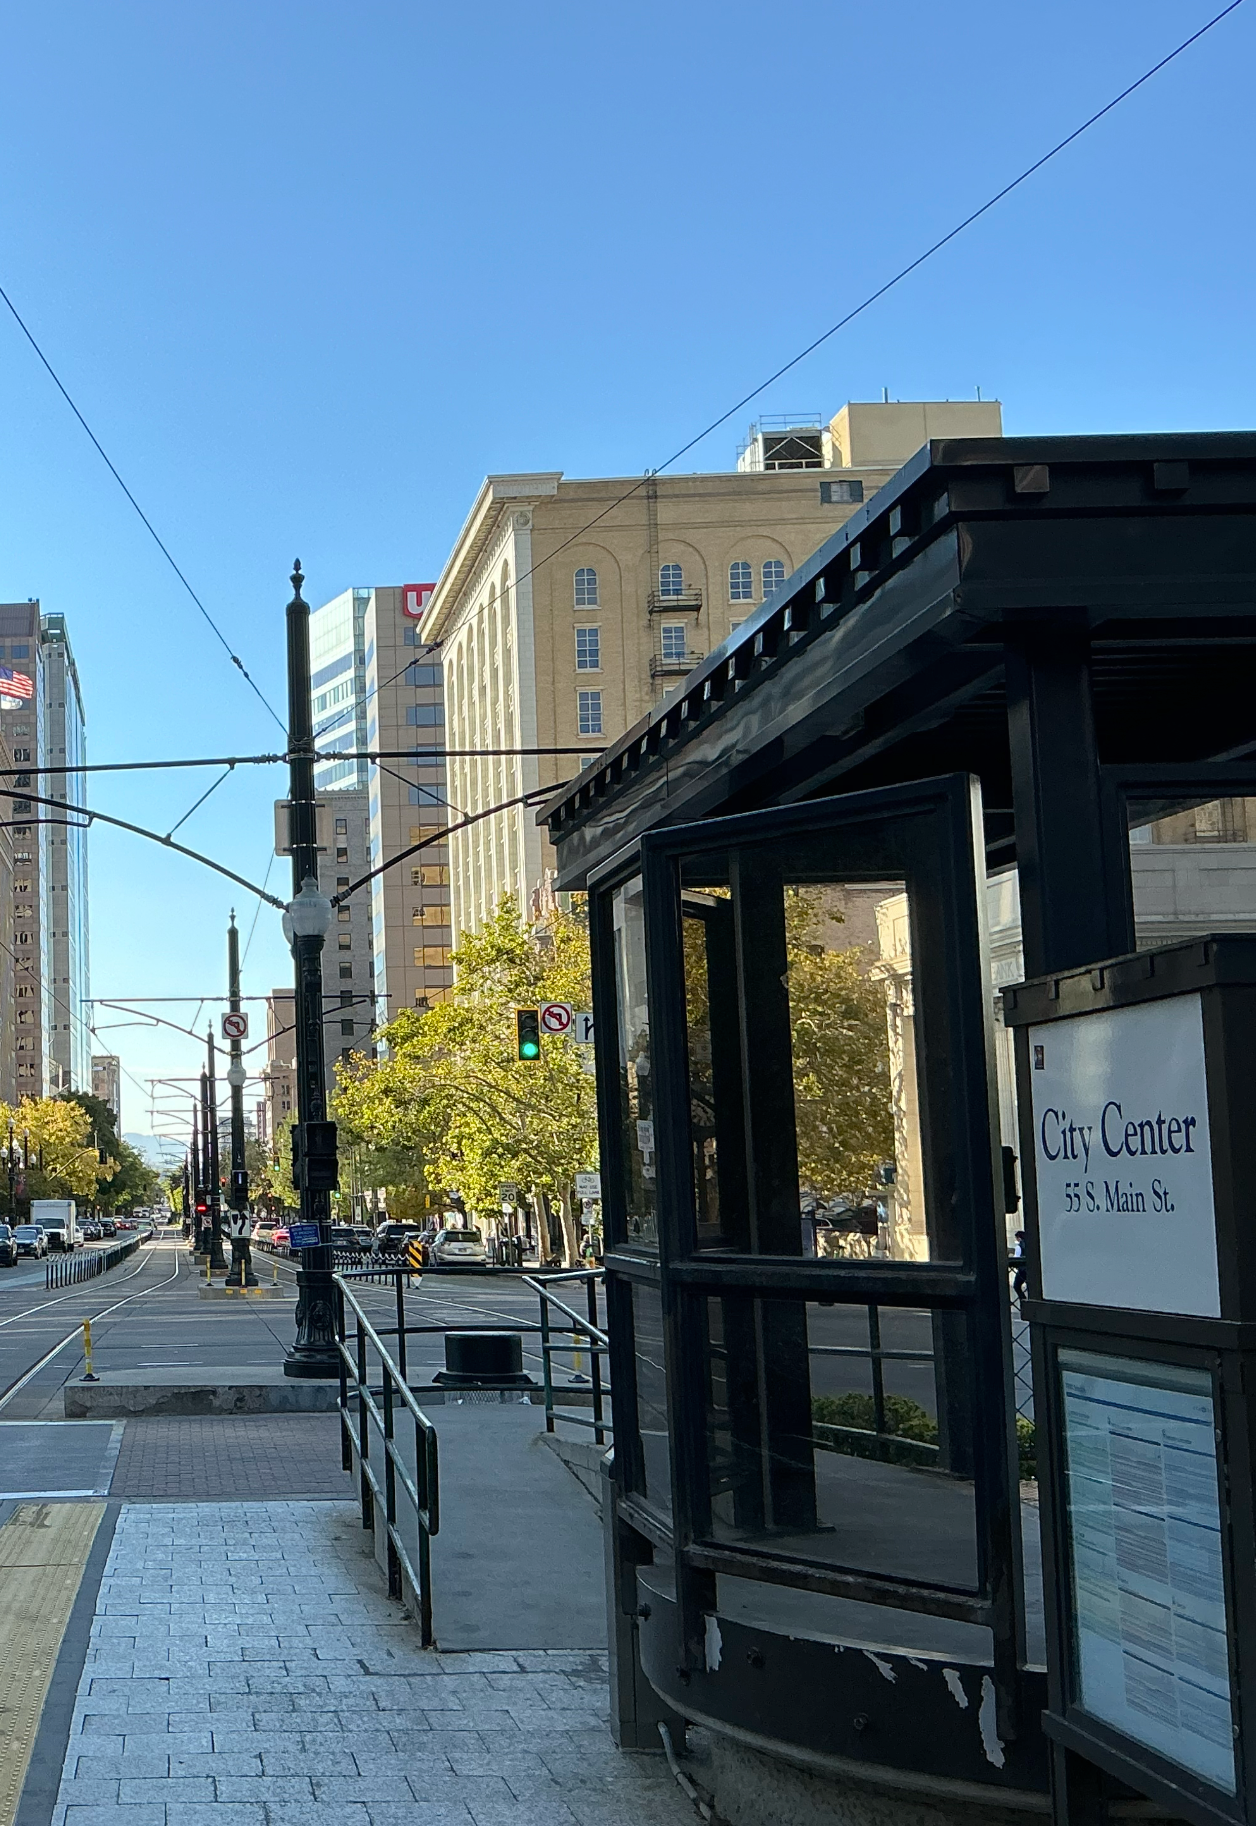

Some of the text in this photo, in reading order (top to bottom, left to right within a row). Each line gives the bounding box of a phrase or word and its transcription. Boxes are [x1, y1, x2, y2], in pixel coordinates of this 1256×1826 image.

[1042, 1101, 1197, 1174] City Center
[501, 1192, 515, 1202] 20
[1065, 1178, 1175, 1213] 55 S. Main St.
